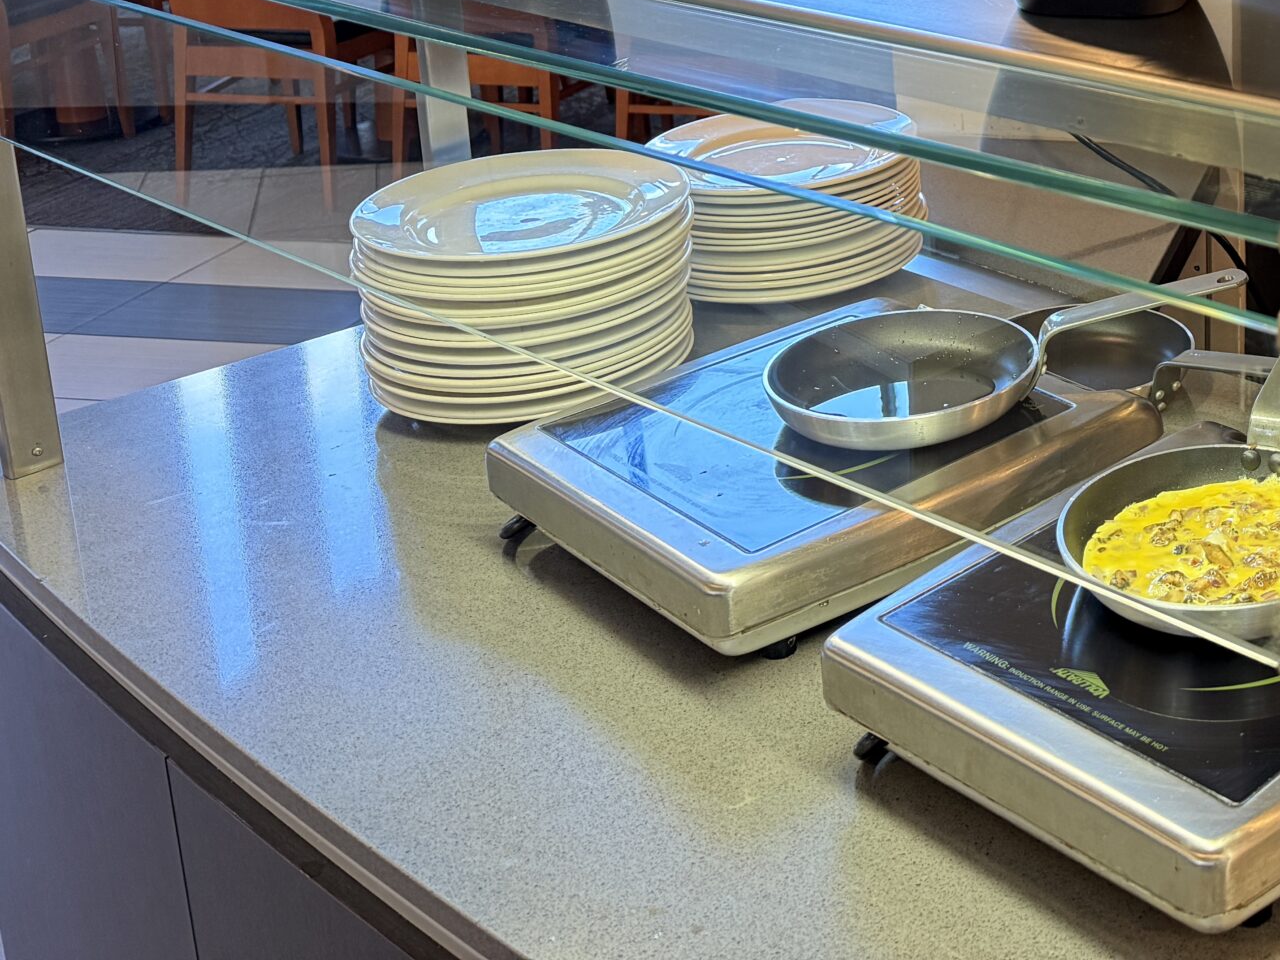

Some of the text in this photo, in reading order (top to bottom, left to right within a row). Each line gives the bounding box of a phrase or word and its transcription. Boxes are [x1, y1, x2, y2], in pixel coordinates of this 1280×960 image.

[963, 641, 1011, 669] WARNING:
[1008, 667, 1046, 688] INDUCTION
[1044, 685, 1069, 700] RANGE
[1067, 697, 1078, 705] IN
[1091, 710, 1126, 730] SURFACE
[1124, 726, 1142, 738] MAY
[1140, 735, 1153, 744] BE
[1151, 741, 1169, 752] HOT
[1055, 668, 1110, 699] VOLLRATH
